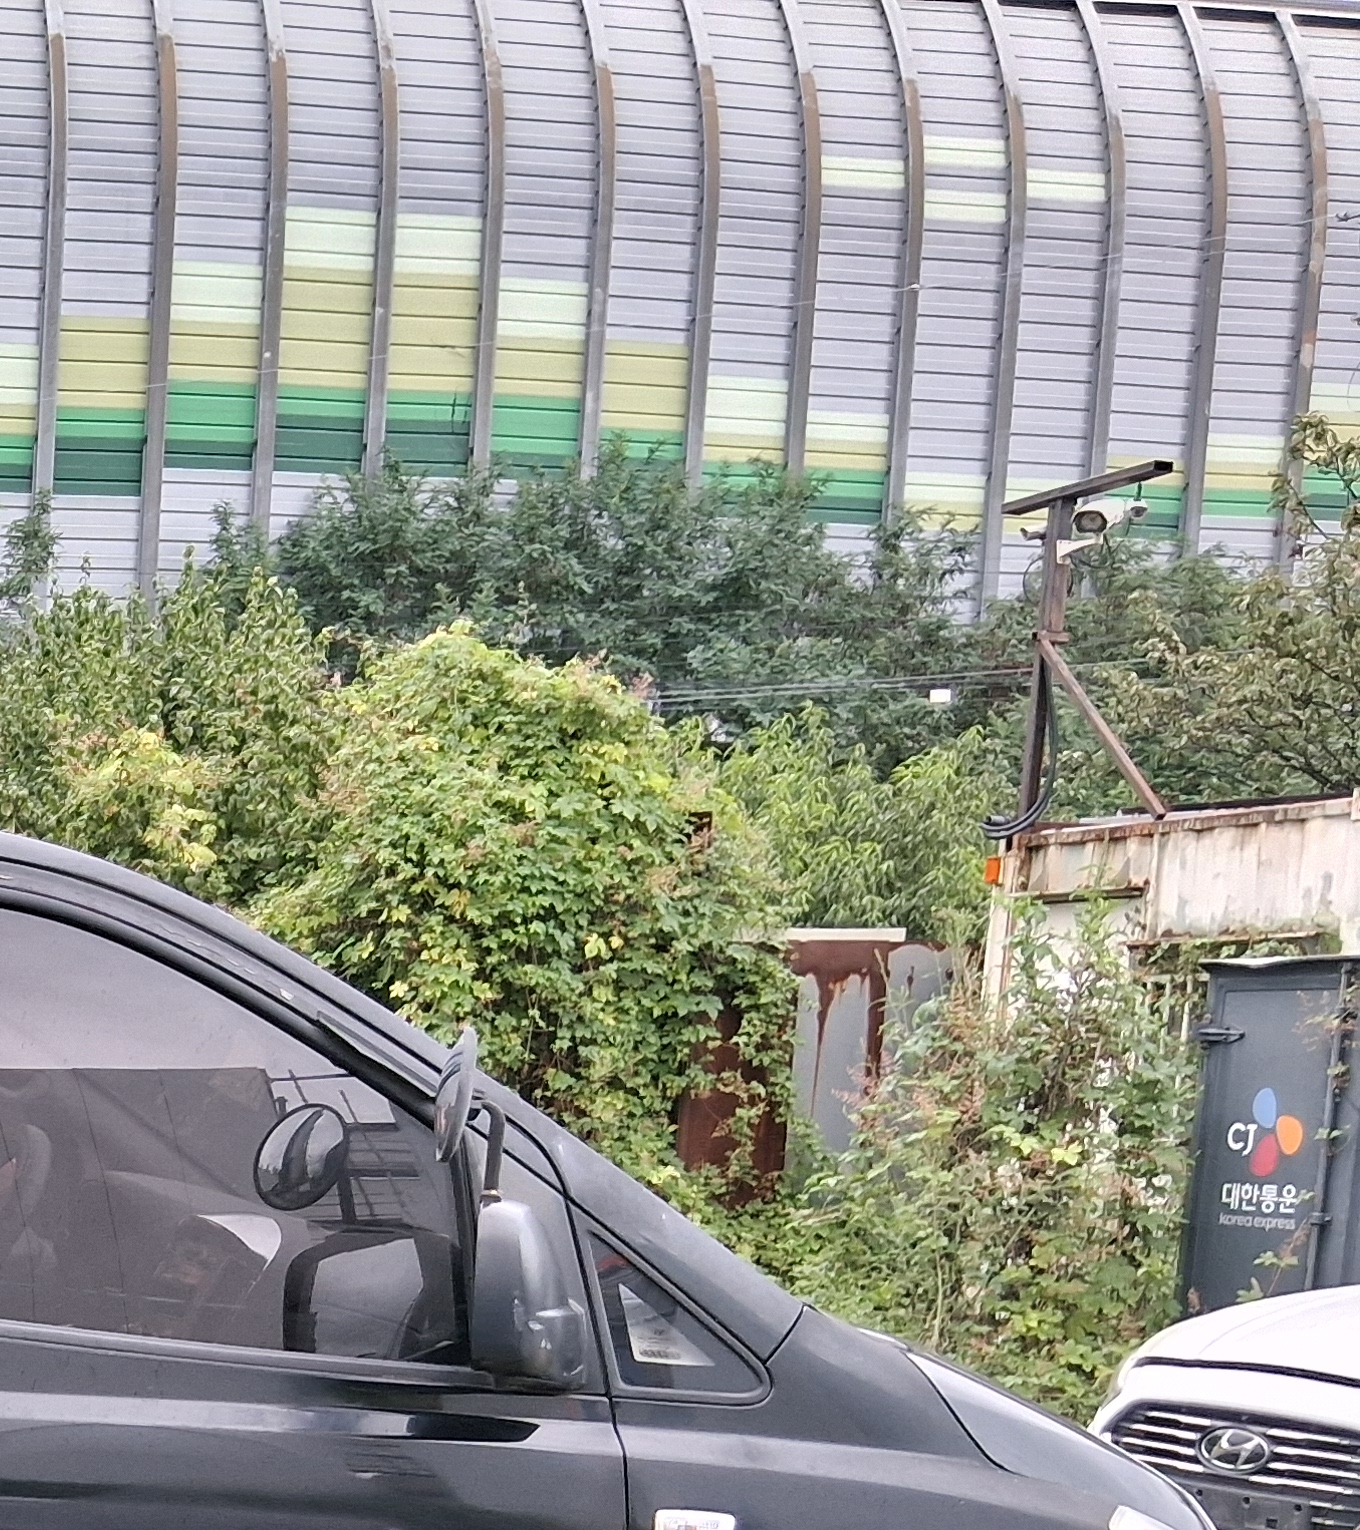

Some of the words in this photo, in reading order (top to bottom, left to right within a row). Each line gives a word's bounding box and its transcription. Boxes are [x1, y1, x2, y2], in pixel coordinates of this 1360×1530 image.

[1227, 1122, 1258, 1156] CJ
[1221, 1183, 1297, 1213] 대한통운
[1219, 1213, 1253, 1227] korea
[1253, 1215, 1296, 1232] express
